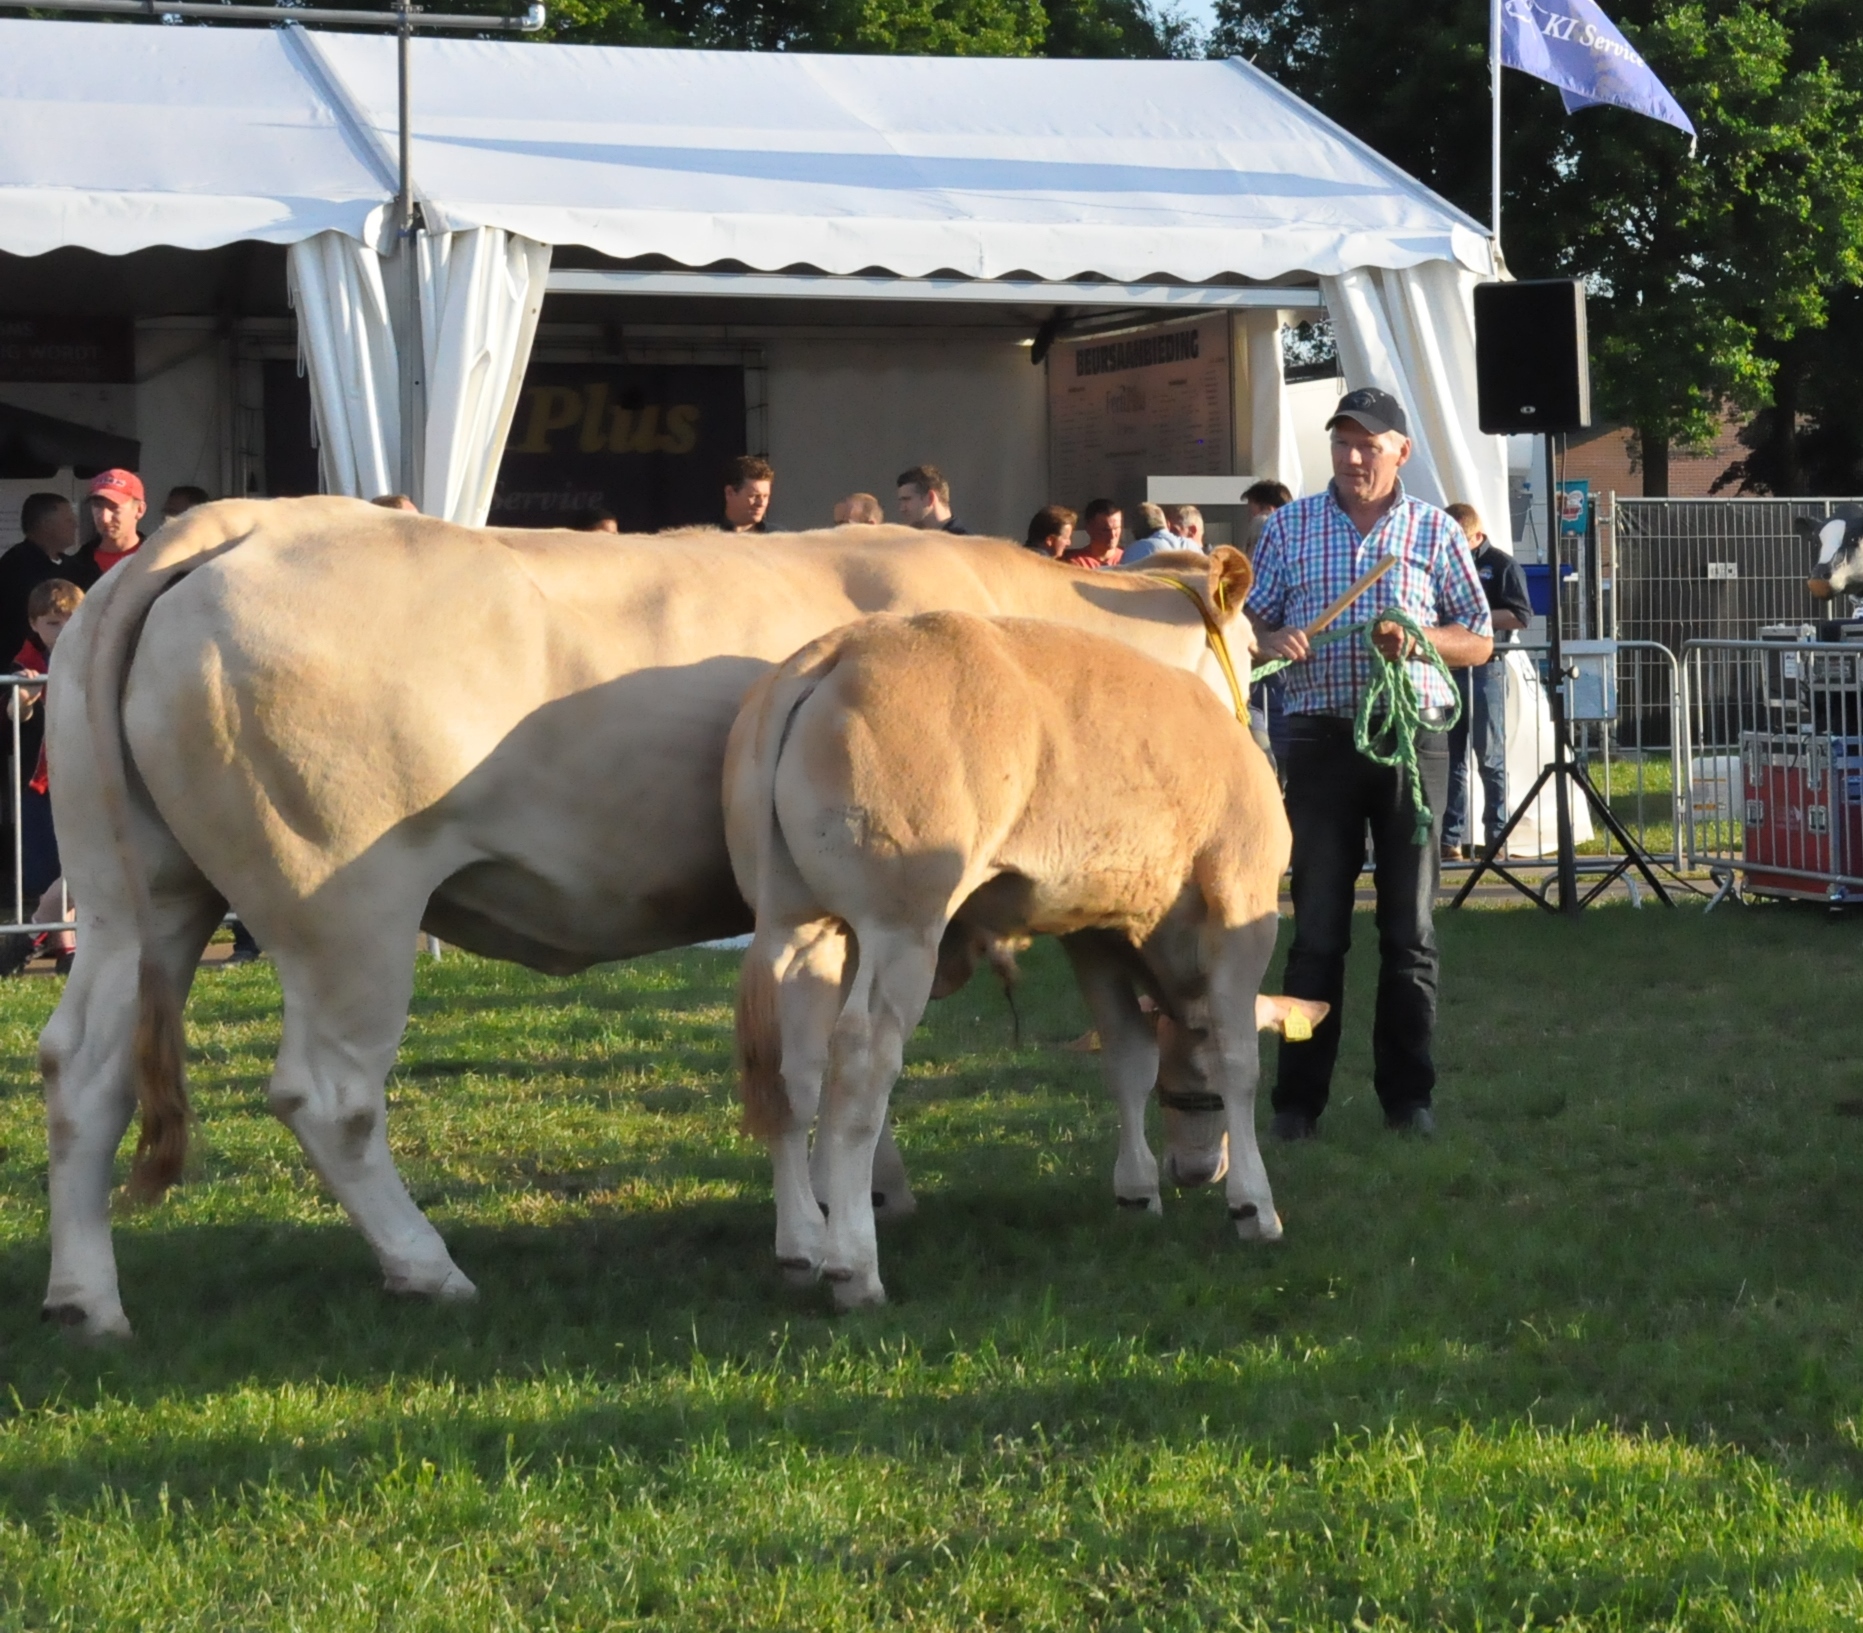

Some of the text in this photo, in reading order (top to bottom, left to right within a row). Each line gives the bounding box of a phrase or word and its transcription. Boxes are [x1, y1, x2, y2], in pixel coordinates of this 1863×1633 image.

[1542, 13, 1644, 68] KI Service
[1076, 329, 1199, 377] BEURSAANBIEDING
[515, 383, 701, 453] Plus
